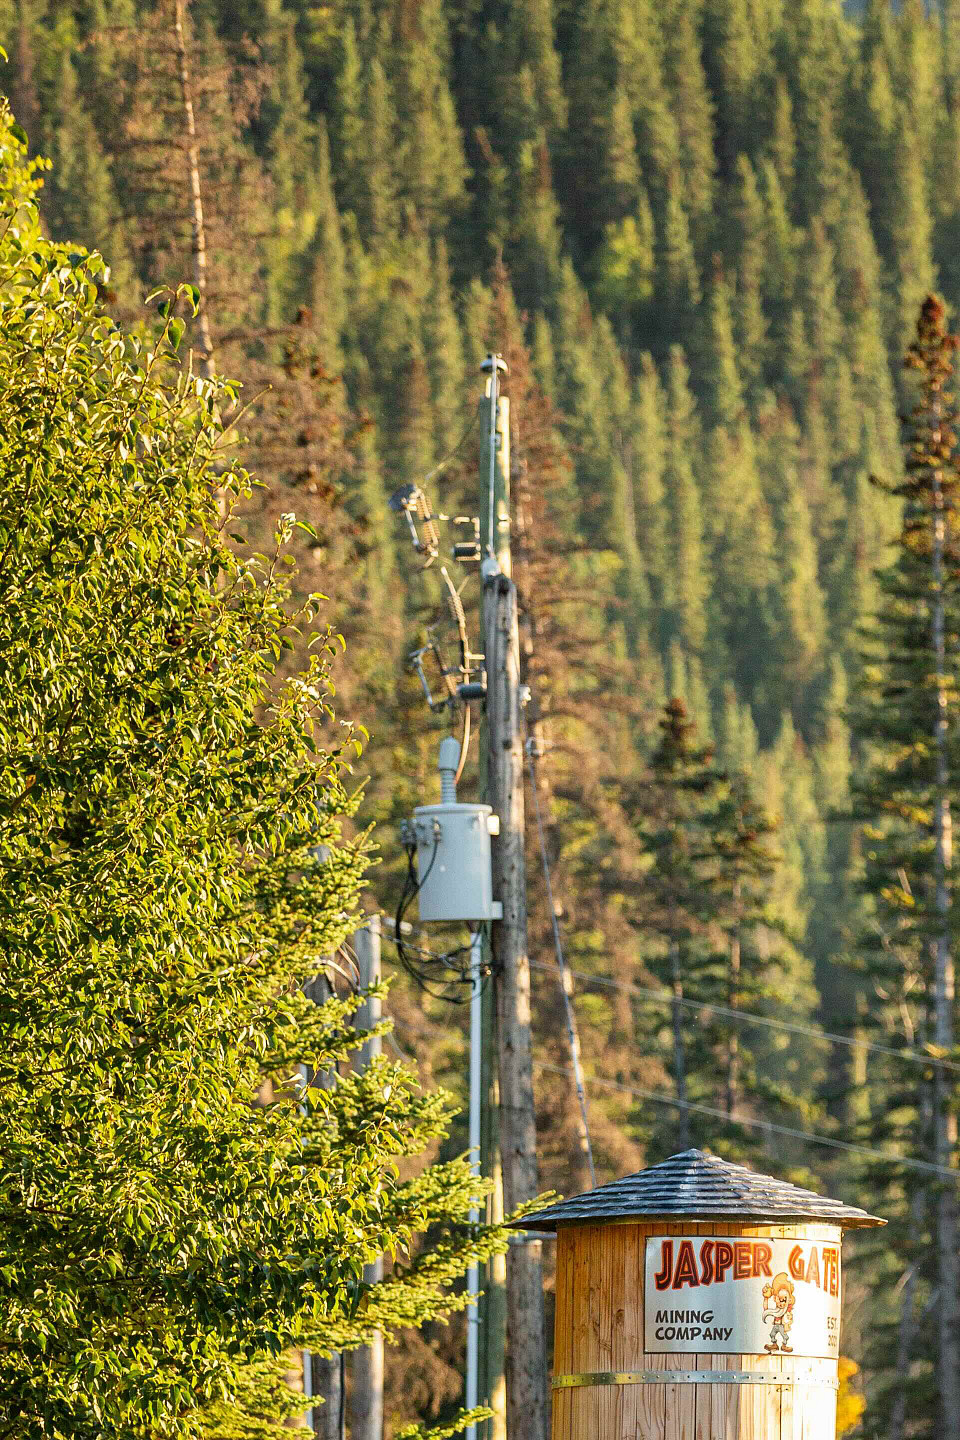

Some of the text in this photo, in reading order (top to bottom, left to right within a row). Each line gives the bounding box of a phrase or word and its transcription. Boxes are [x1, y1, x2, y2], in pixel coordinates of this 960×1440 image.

[654, 1239, 773, 1291] JASPER
[655, 1310, 714, 1324] MINING
[655, 1326, 733, 1341] COMPANY
